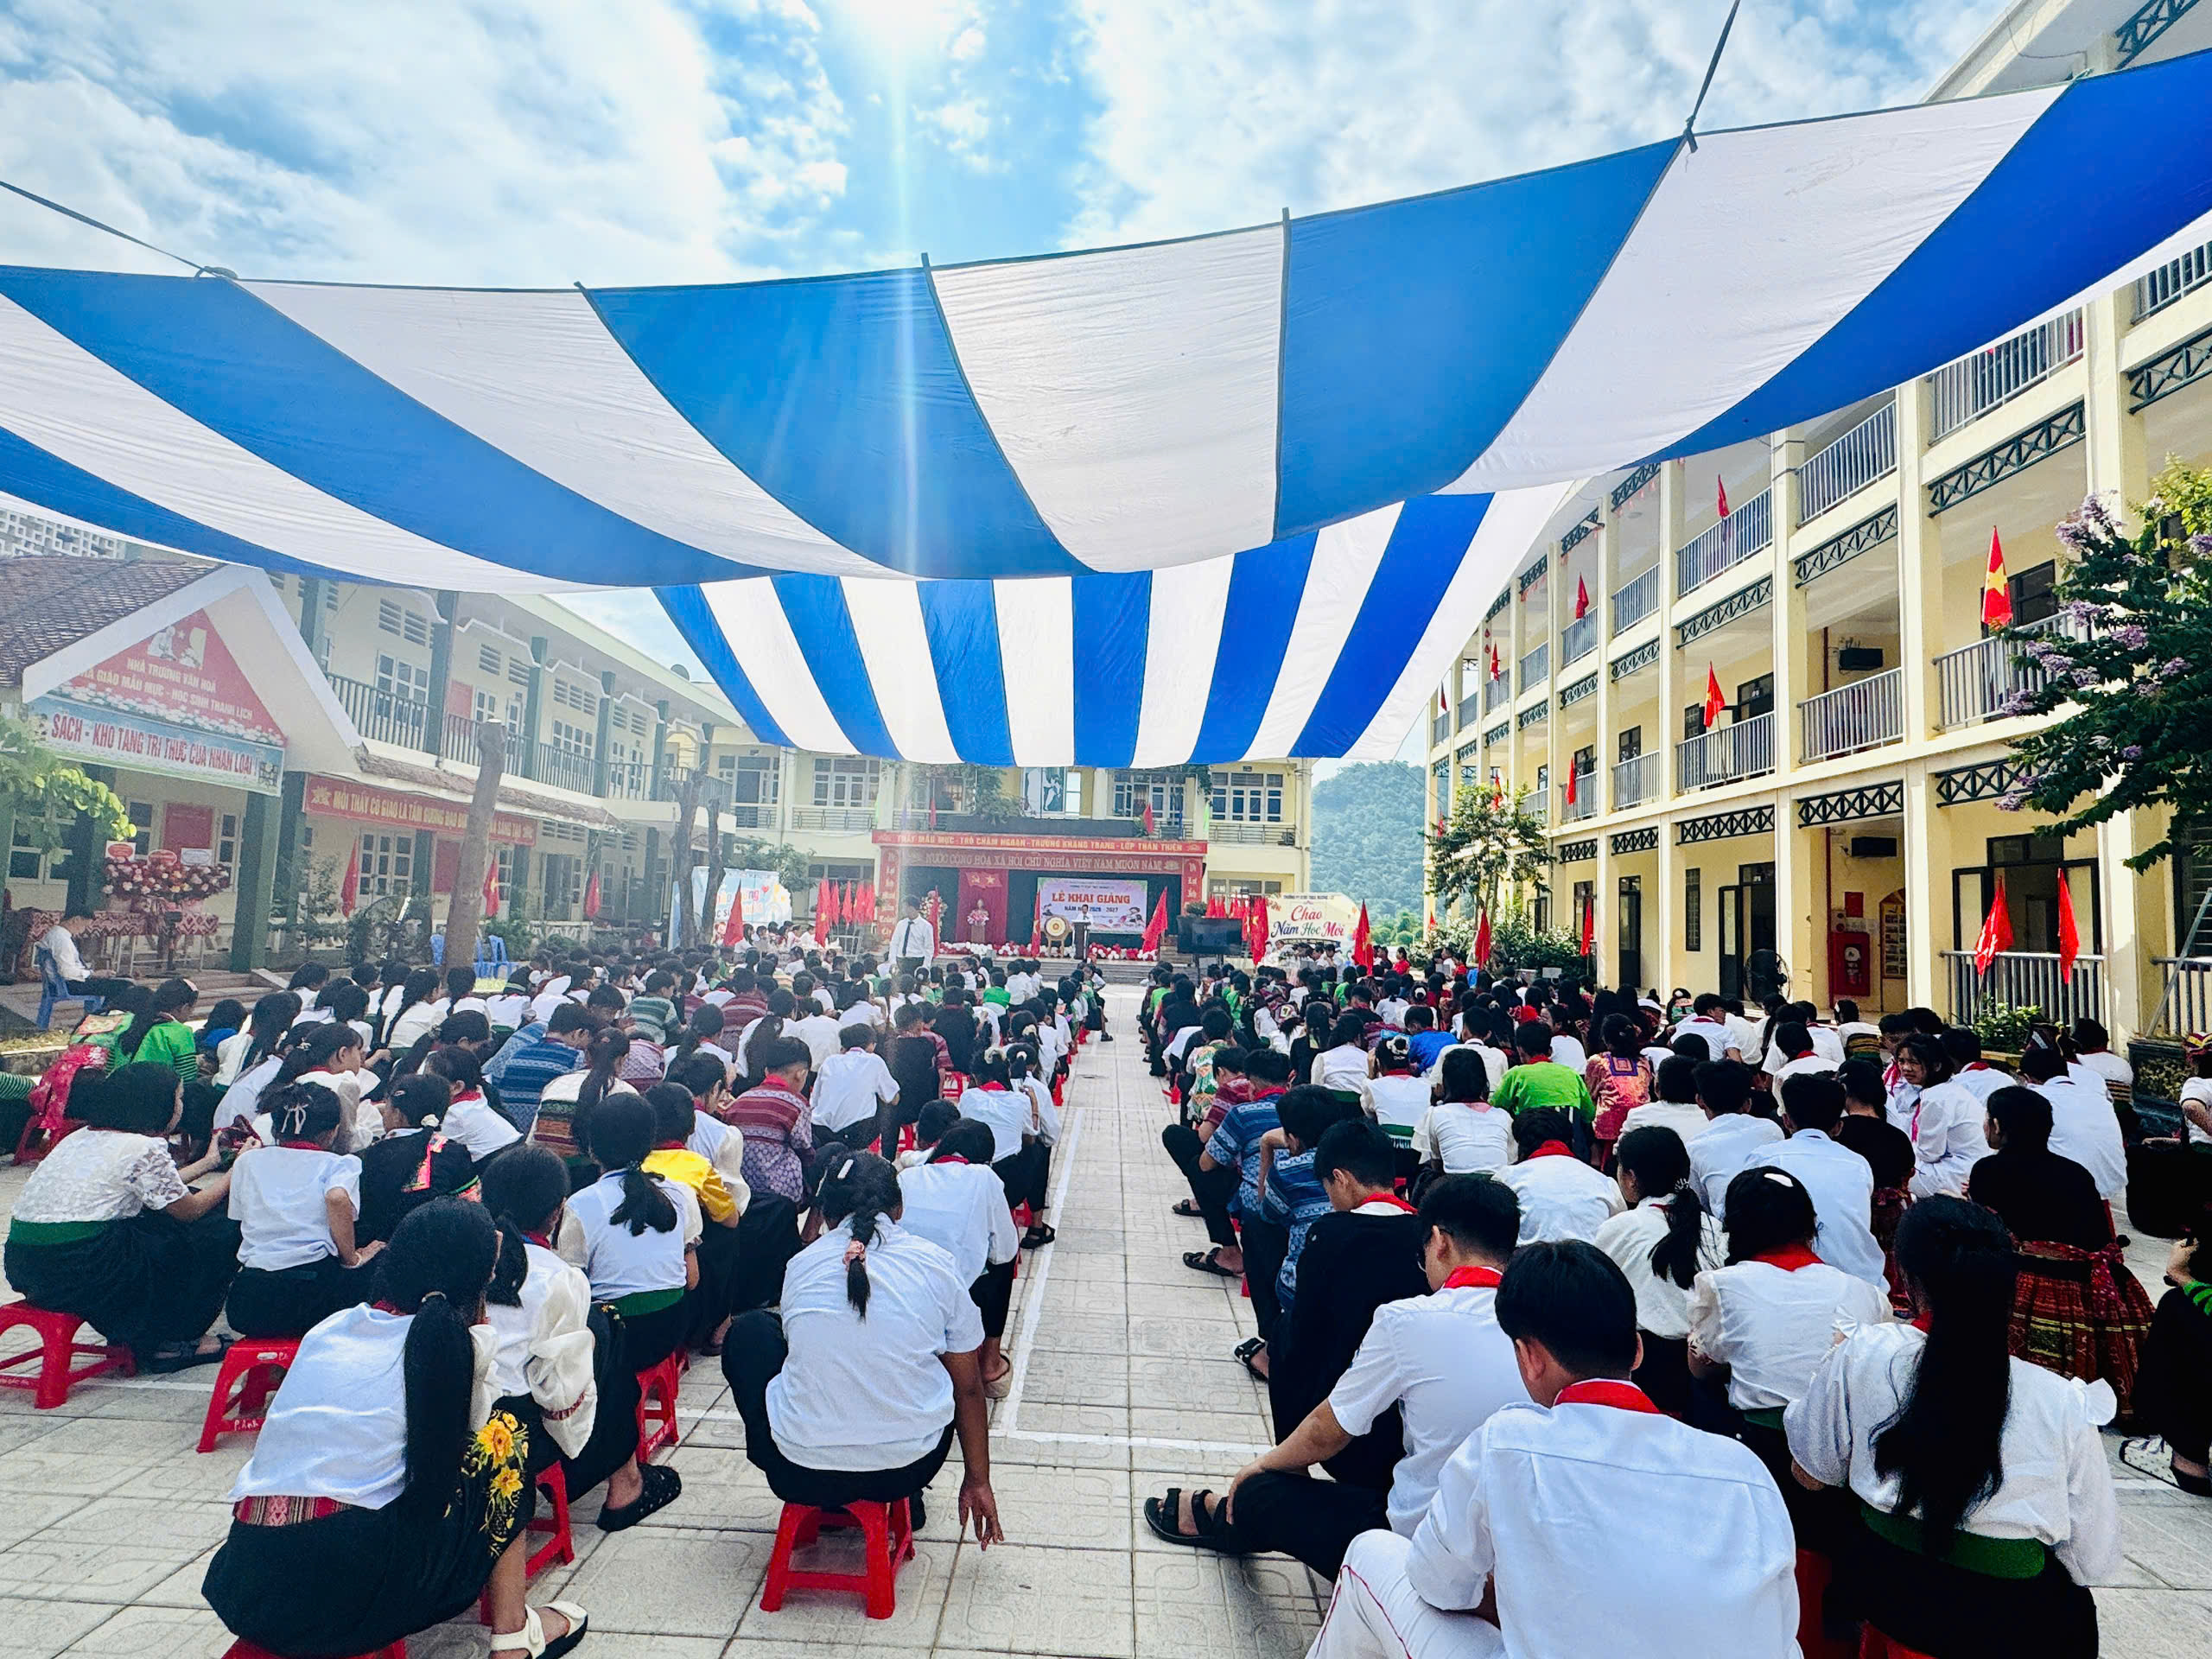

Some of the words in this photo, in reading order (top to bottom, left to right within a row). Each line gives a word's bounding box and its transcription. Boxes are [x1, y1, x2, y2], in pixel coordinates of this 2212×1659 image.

[51, 710, 83, 743] SÁCH
[92, 721, 115, 749] KHO
[118, 723, 144, 754] TÀNG
[146, 733, 162, 758] TRI
[1094, 858, 1114, 869] NAM
[1052, 889, 1065, 902] LỄ
[1068, 893, 1094, 903] KHAI
[1096, 892, 1130, 905] GIẢNG
[1291, 905, 1322, 922] Chào
[1270, 920, 1300, 938] Năm
[1320, 921, 1345, 938] Mới
